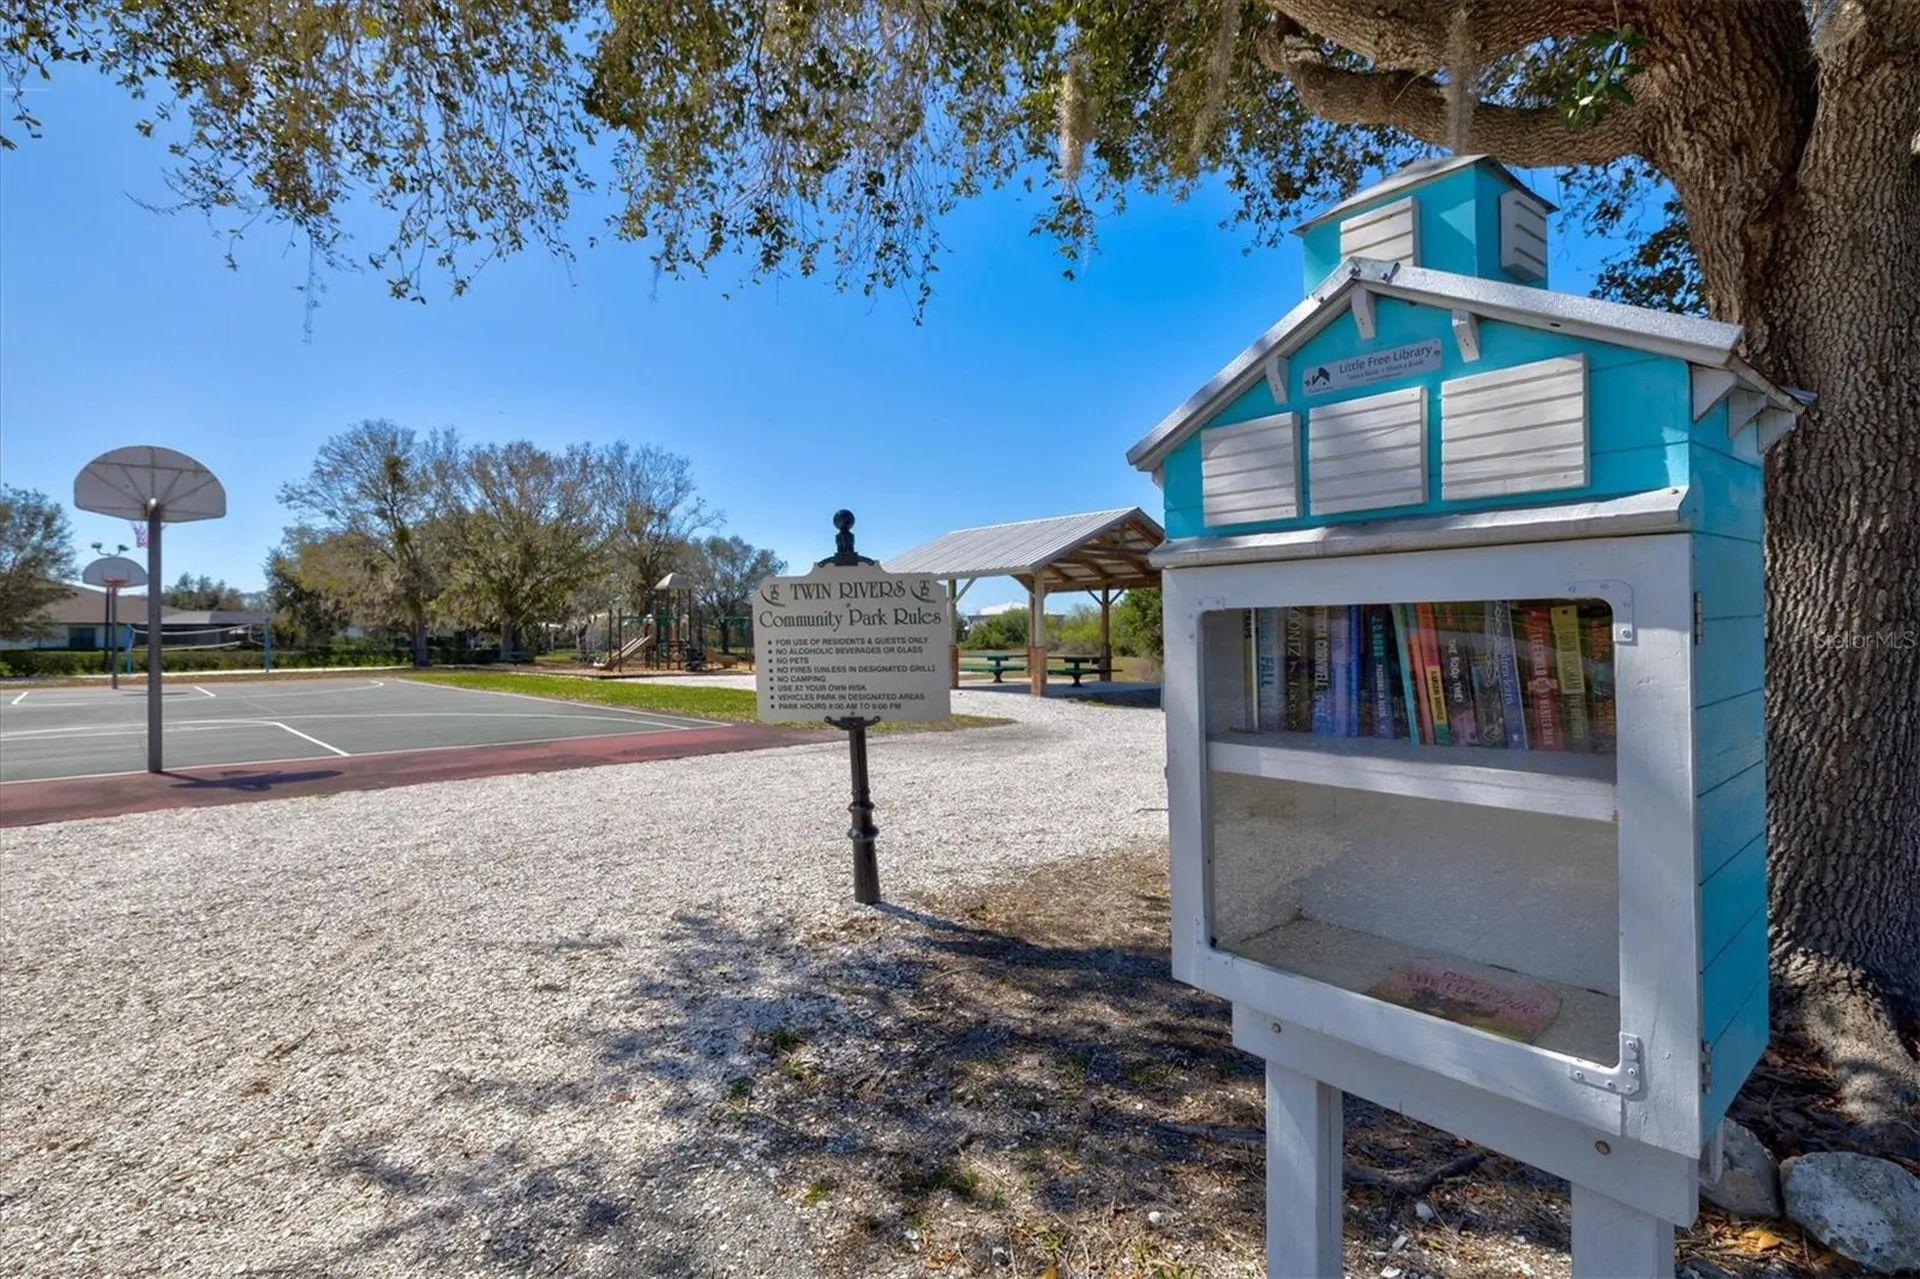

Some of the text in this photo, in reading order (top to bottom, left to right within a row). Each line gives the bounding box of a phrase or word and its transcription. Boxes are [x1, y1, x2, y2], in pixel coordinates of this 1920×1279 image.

[1339, 345, 1434, 375] Little Free Library
[789, 580, 906, 600] TWIN RIVERS
[759, 606, 942, 632] Community Park Rules
[793, 638, 808, 646] USE
[809, 638, 820, 646] OF
[822, 637, 865, 646] RESIDENTS
[874, 636, 906, 645] GUESTS
[907, 636, 928, 644] ONLY
[789, 647, 834, 655] ALCOHOLIC
[835, 646, 881, 655] BEVERAGES
[883, 646, 895, 654] OR
[896, 645, 924, 654] GLASS
[776, 657, 788, 665] NO
[777, 666, 788, 674] NO
[790, 666, 812, 674] FIRES
[848, 665, 857, 673] IN
[858, 664, 908, 673] DESIGNATED
[1260, 656, 1275, 686] FALL
[790, 675, 826, 683] CAMPING
[777, 684, 793, 692] USE
[795, 684, 804, 692] AT
[805, 684, 827, 692] YOUR
[848, 683, 867, 691] RISK
[816, 693, 837, 701] PARK
[847, 692, 898, 701] DESIGNATED
[899, 692, 926, 700] AREAS
[845, 702, 858, 710] AM
[860, 702, 870, 710] TO
[889, 701, 902, 709] PM
